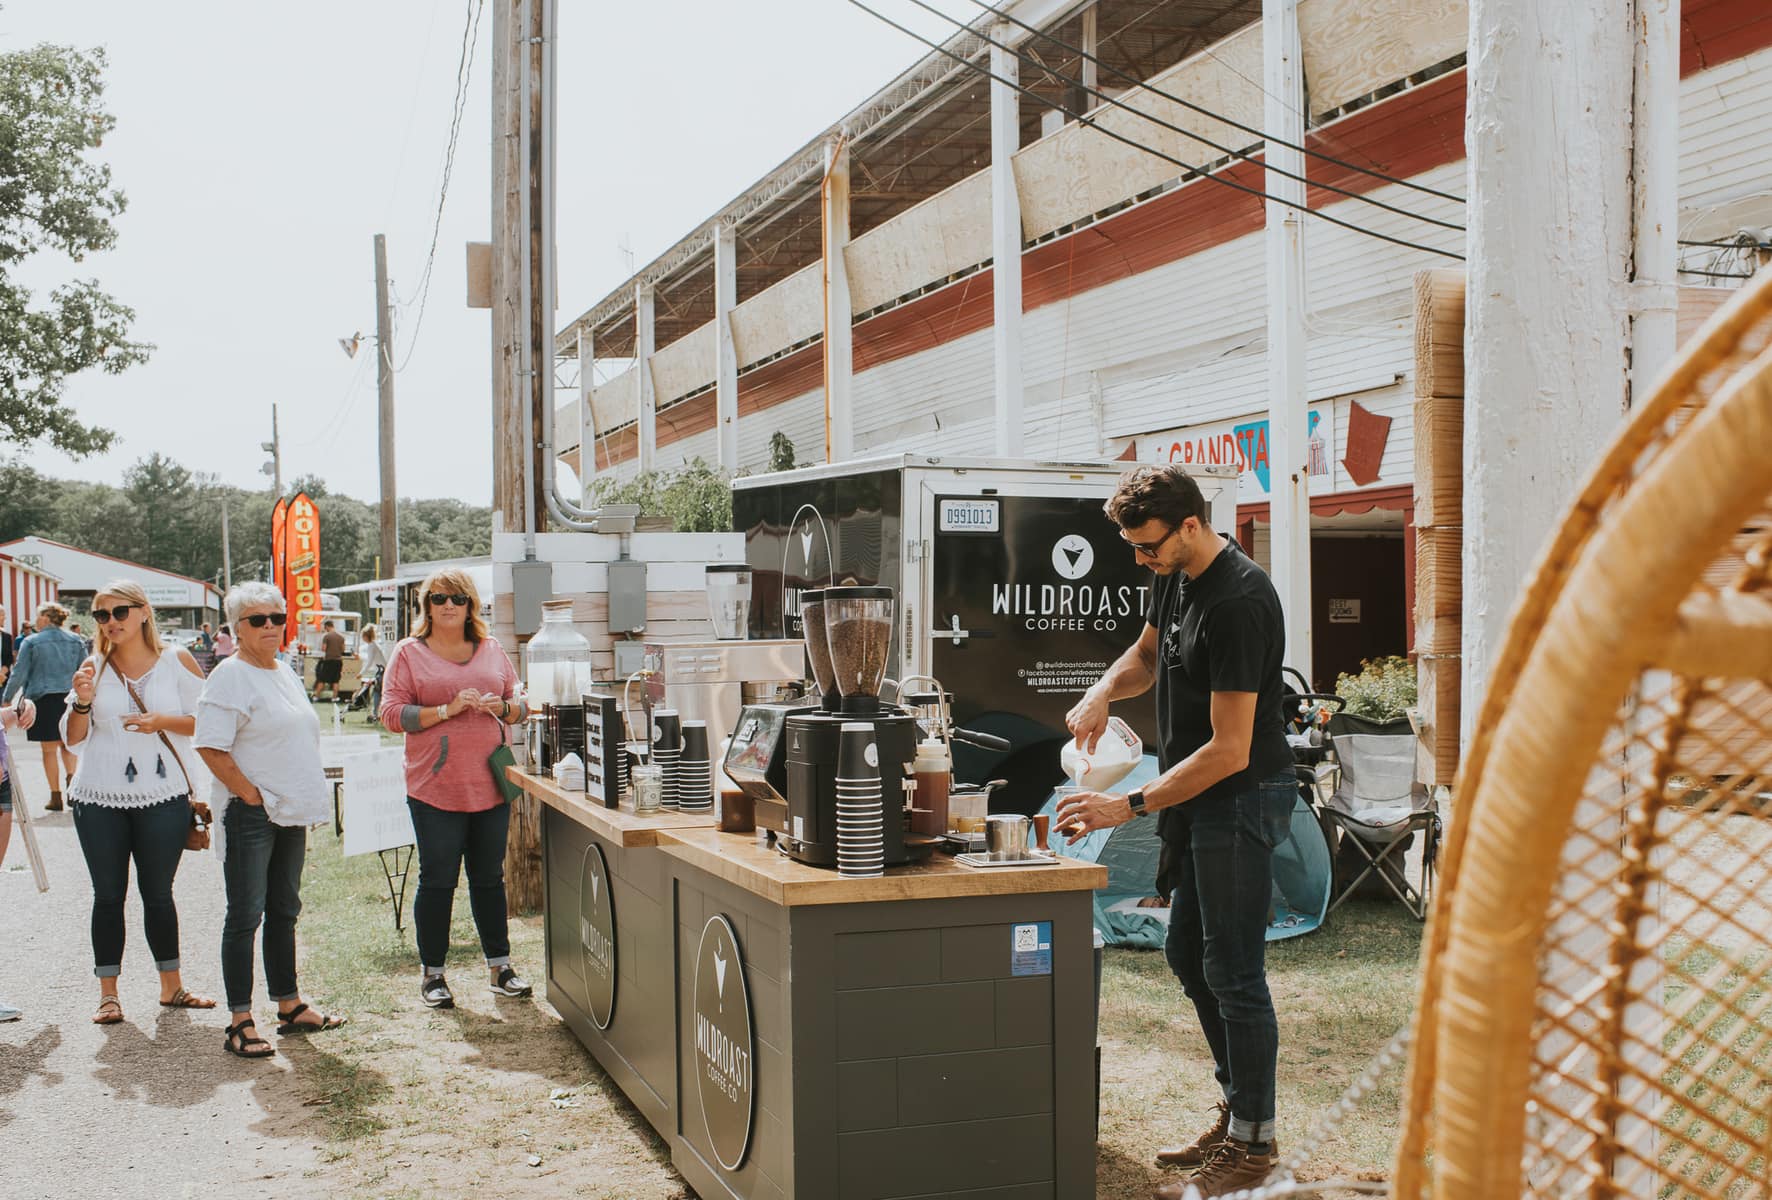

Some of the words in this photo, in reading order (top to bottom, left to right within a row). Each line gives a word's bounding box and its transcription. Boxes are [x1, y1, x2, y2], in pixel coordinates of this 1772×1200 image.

[1168, 427, 1270, 474] GRANDSTA
[294, 501, 313, 550] HOT
[295, 575, 315, 624] DOG
[992, 583, 1149, 616] WILDROAST
[384, 631, 396, 641] 10
[1025, 618, 1085, 631] COFFEE
[1093, 619, 1117, 631] CO
[1027, 677, 1099, 686] WILDROASTCOFFEECO
[581, 914, 611, 972] WILDROAST
[697, 1011, 748, 1093] WILDROAST
[706, 1063, 727, 1093] COFFEE
[728, 1083, 738, 1103] CO
